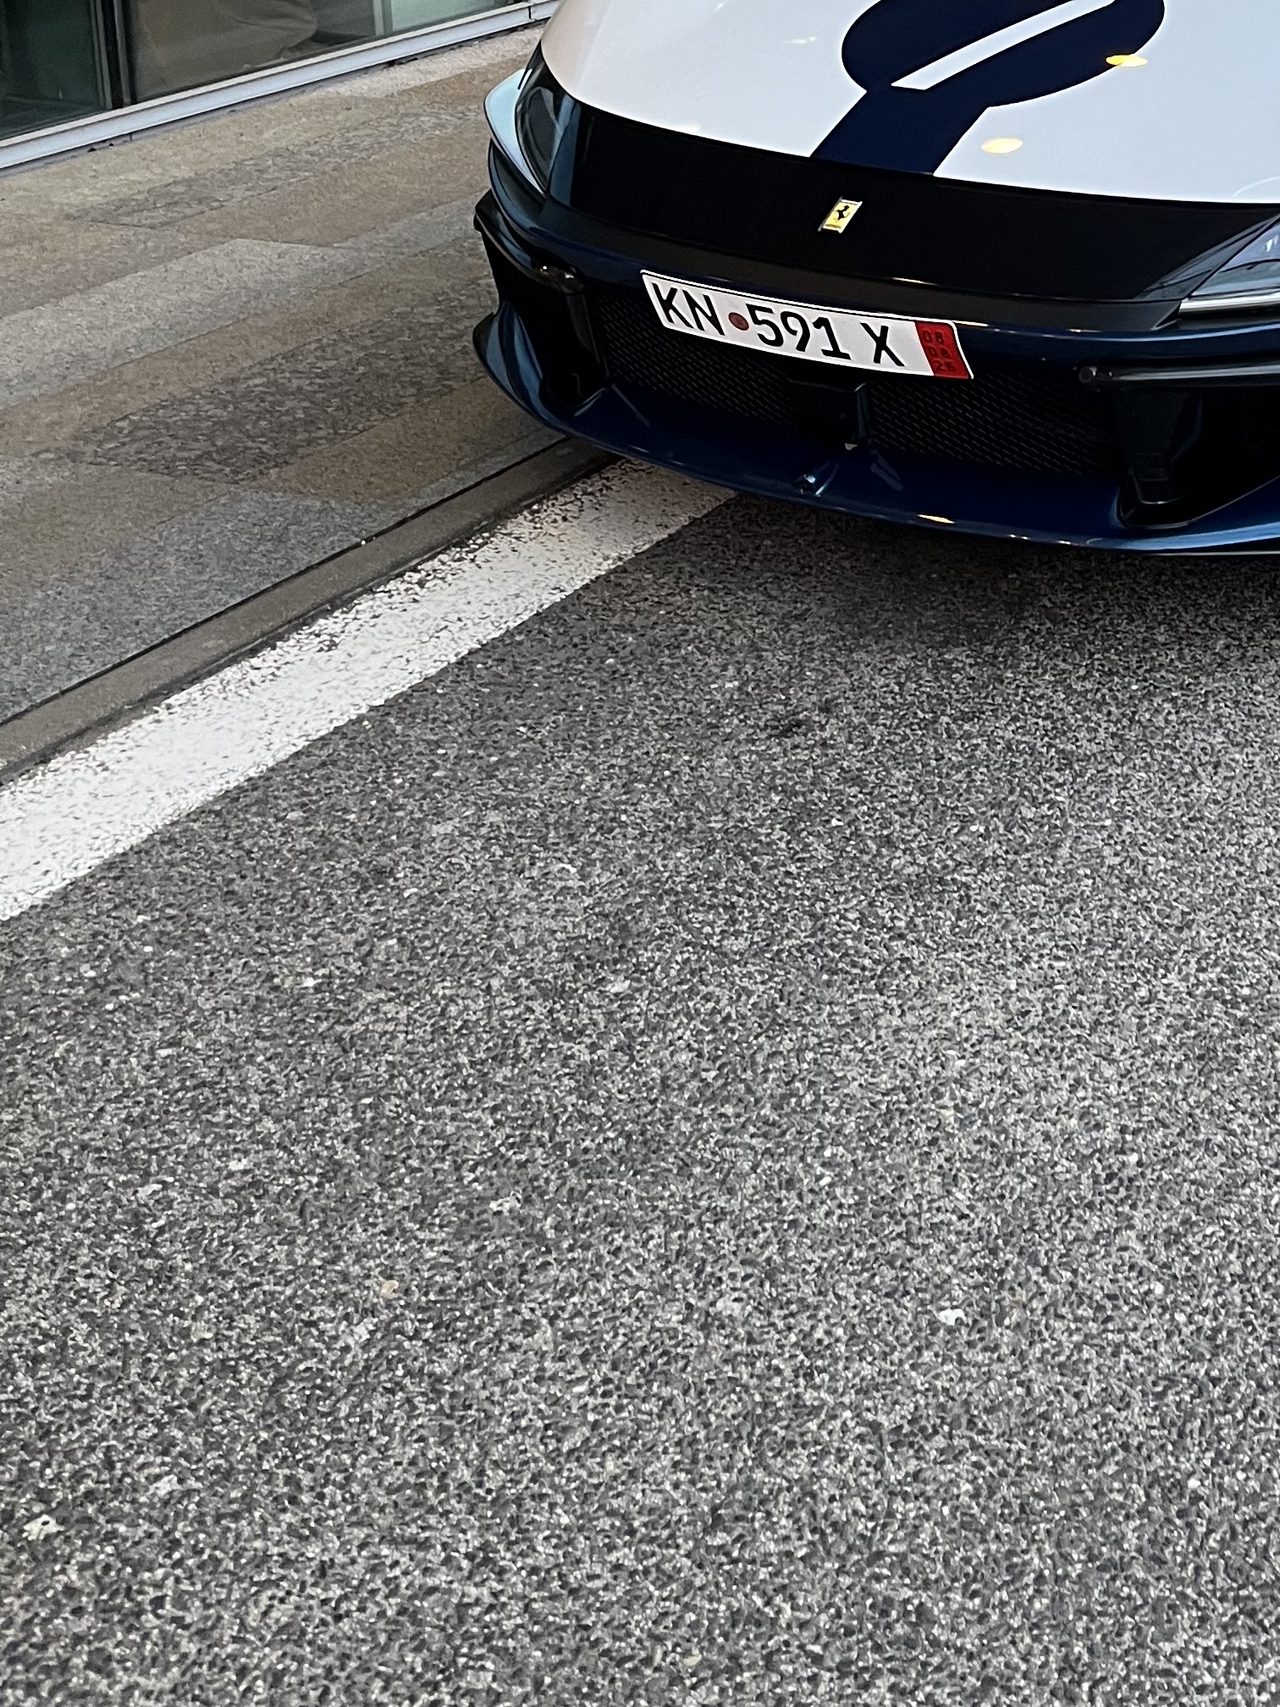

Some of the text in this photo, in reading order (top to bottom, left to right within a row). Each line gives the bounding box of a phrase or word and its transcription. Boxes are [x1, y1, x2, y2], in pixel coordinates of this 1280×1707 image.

[651, 282, 906, 367] KN 591 X
